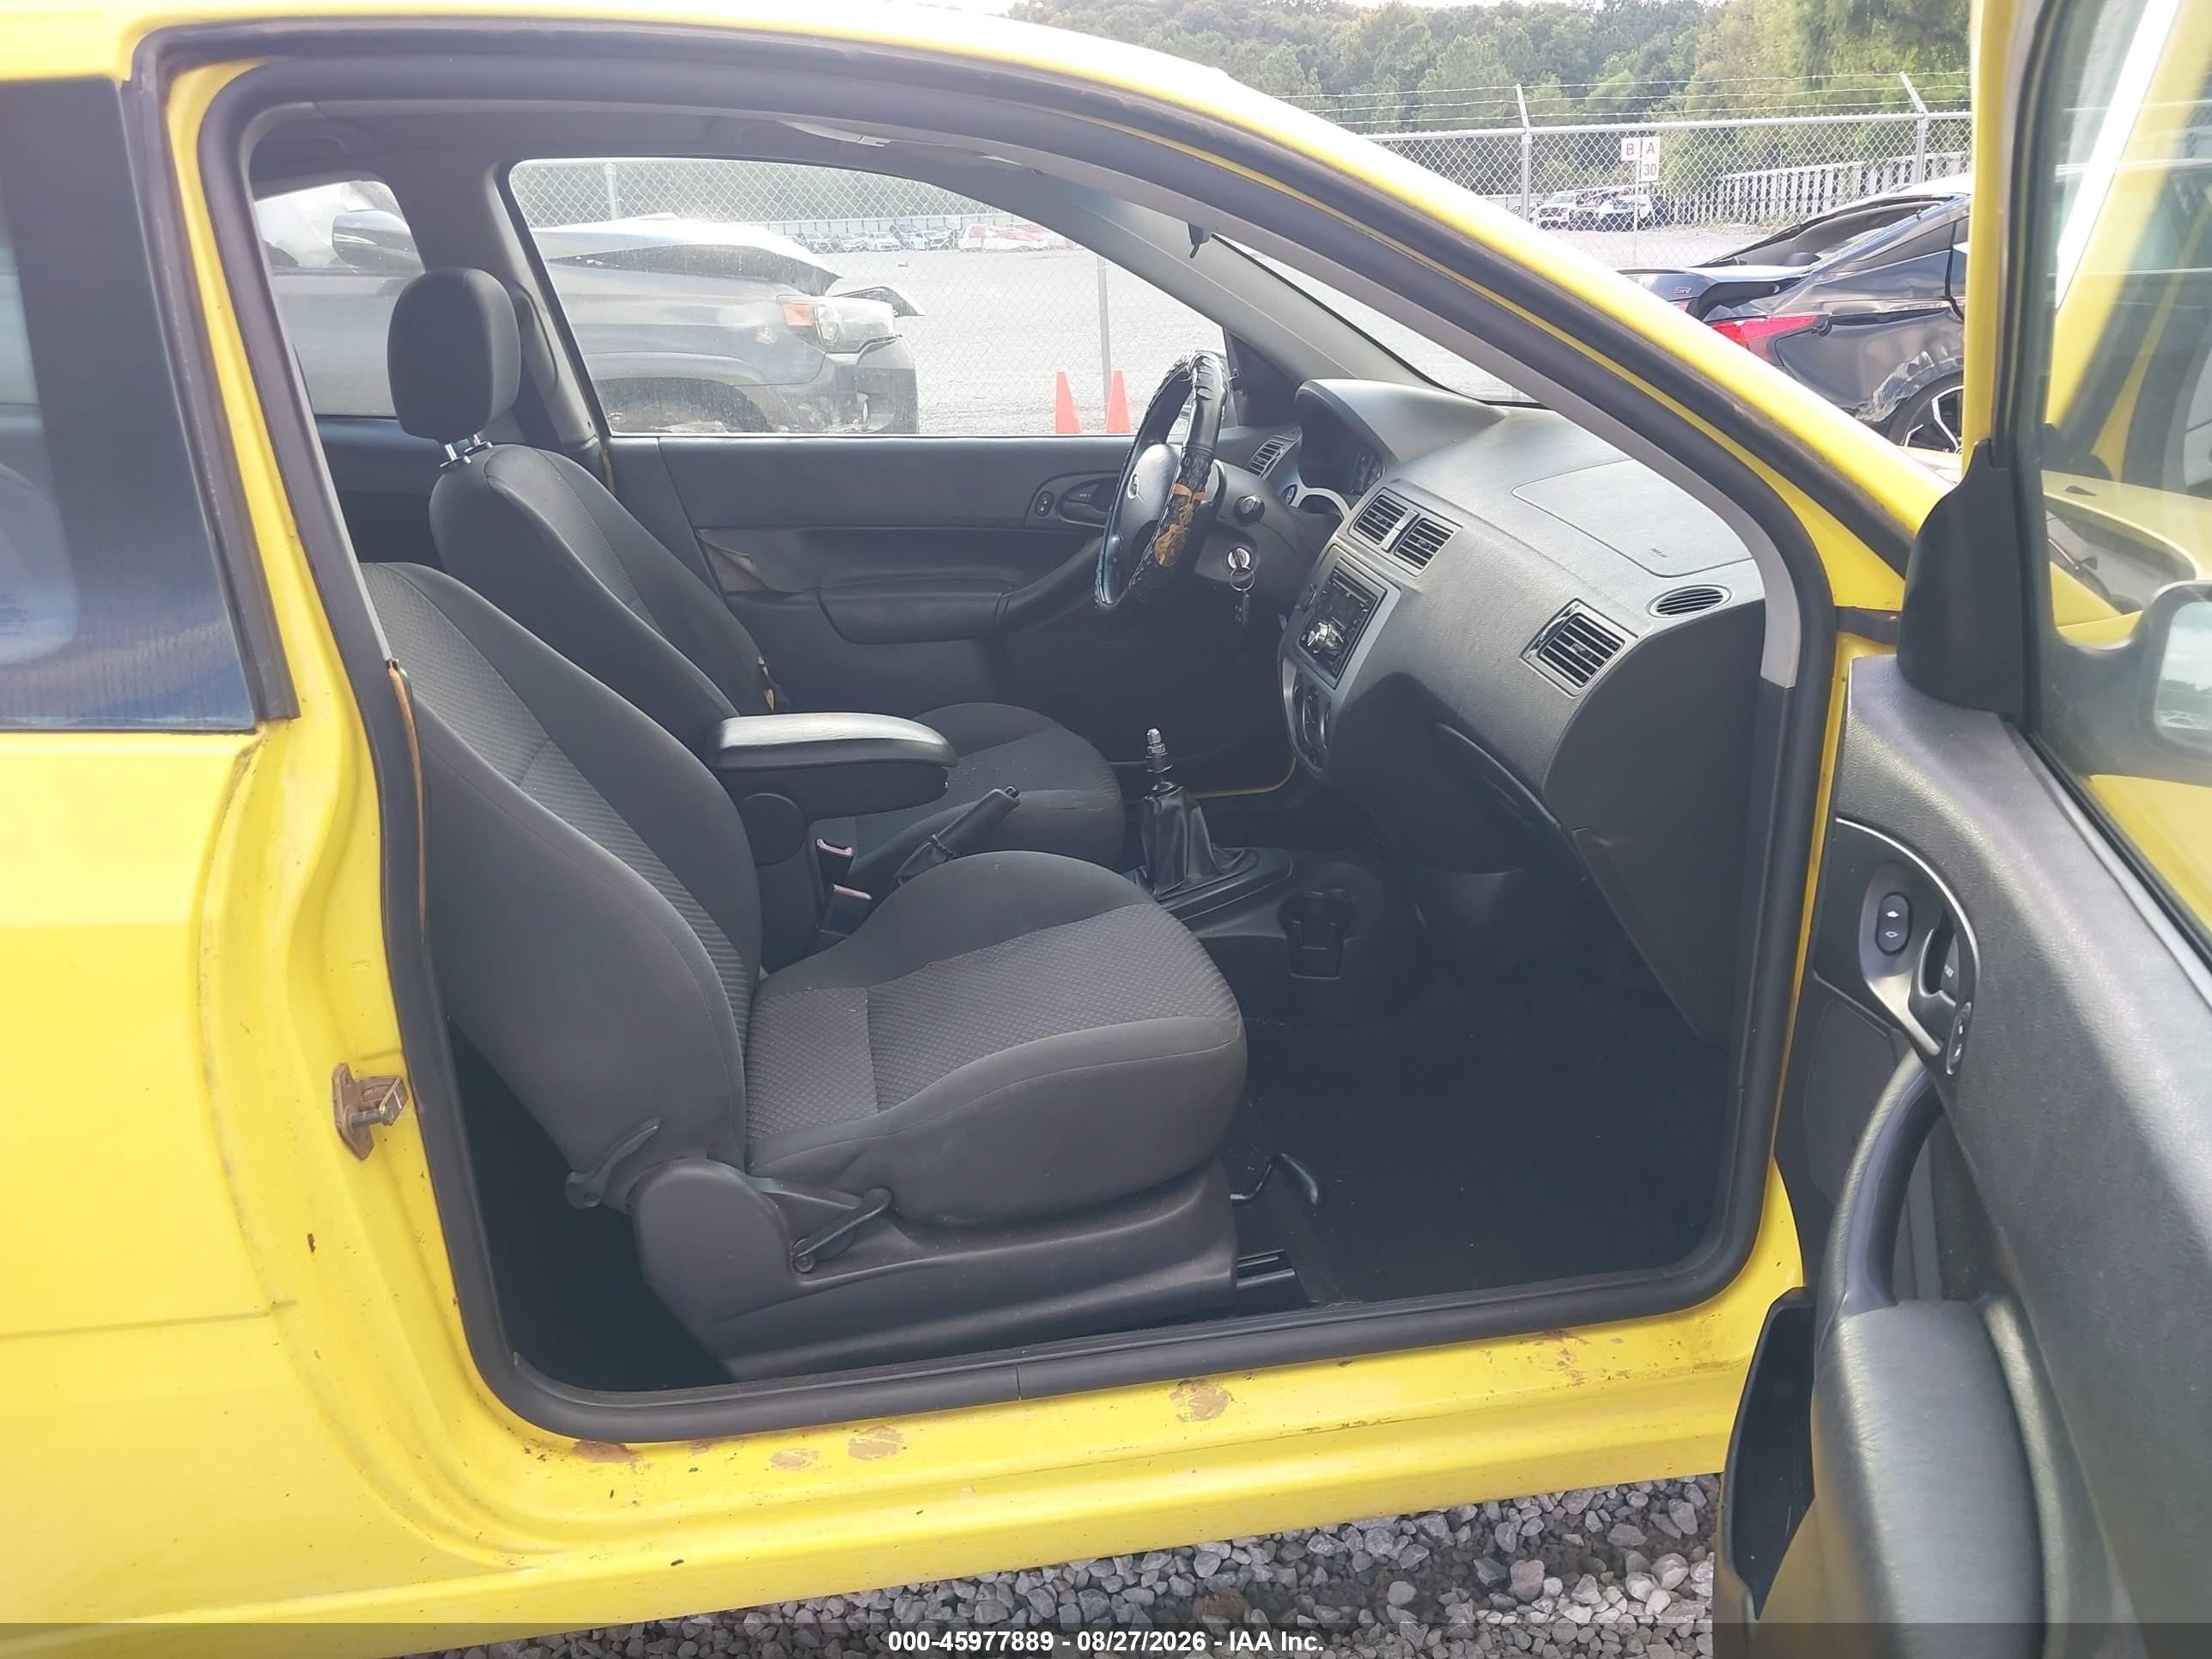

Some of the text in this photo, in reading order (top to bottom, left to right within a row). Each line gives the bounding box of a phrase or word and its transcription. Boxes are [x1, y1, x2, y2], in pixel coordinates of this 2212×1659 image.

[1626, 143, 1634, 155] B
[1646, 143, 1656, 155] A
[1644, 163, 1657, 176] 30
